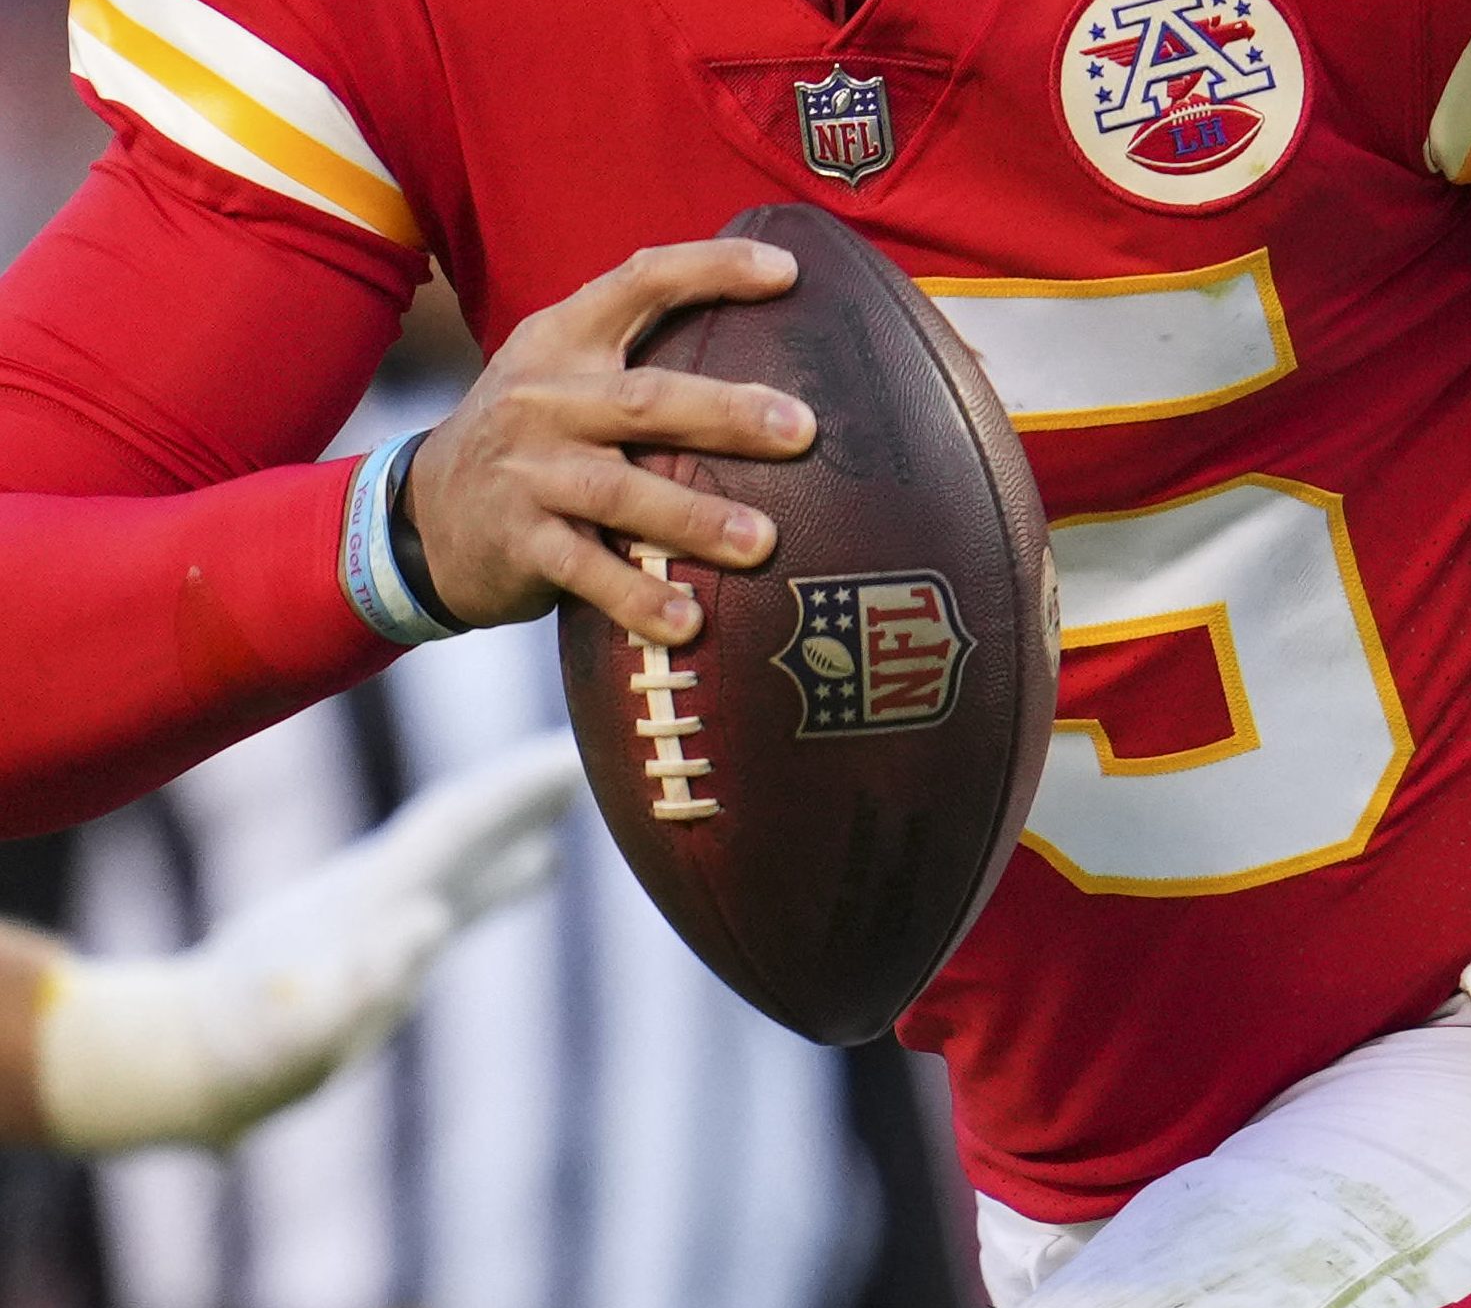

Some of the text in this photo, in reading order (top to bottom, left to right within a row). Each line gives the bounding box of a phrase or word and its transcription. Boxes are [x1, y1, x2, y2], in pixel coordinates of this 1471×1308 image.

[812, 119, 880, 166] NFL
[1171, 118, 1227, 157] LH
[866, 585, 952, 717] NFL
